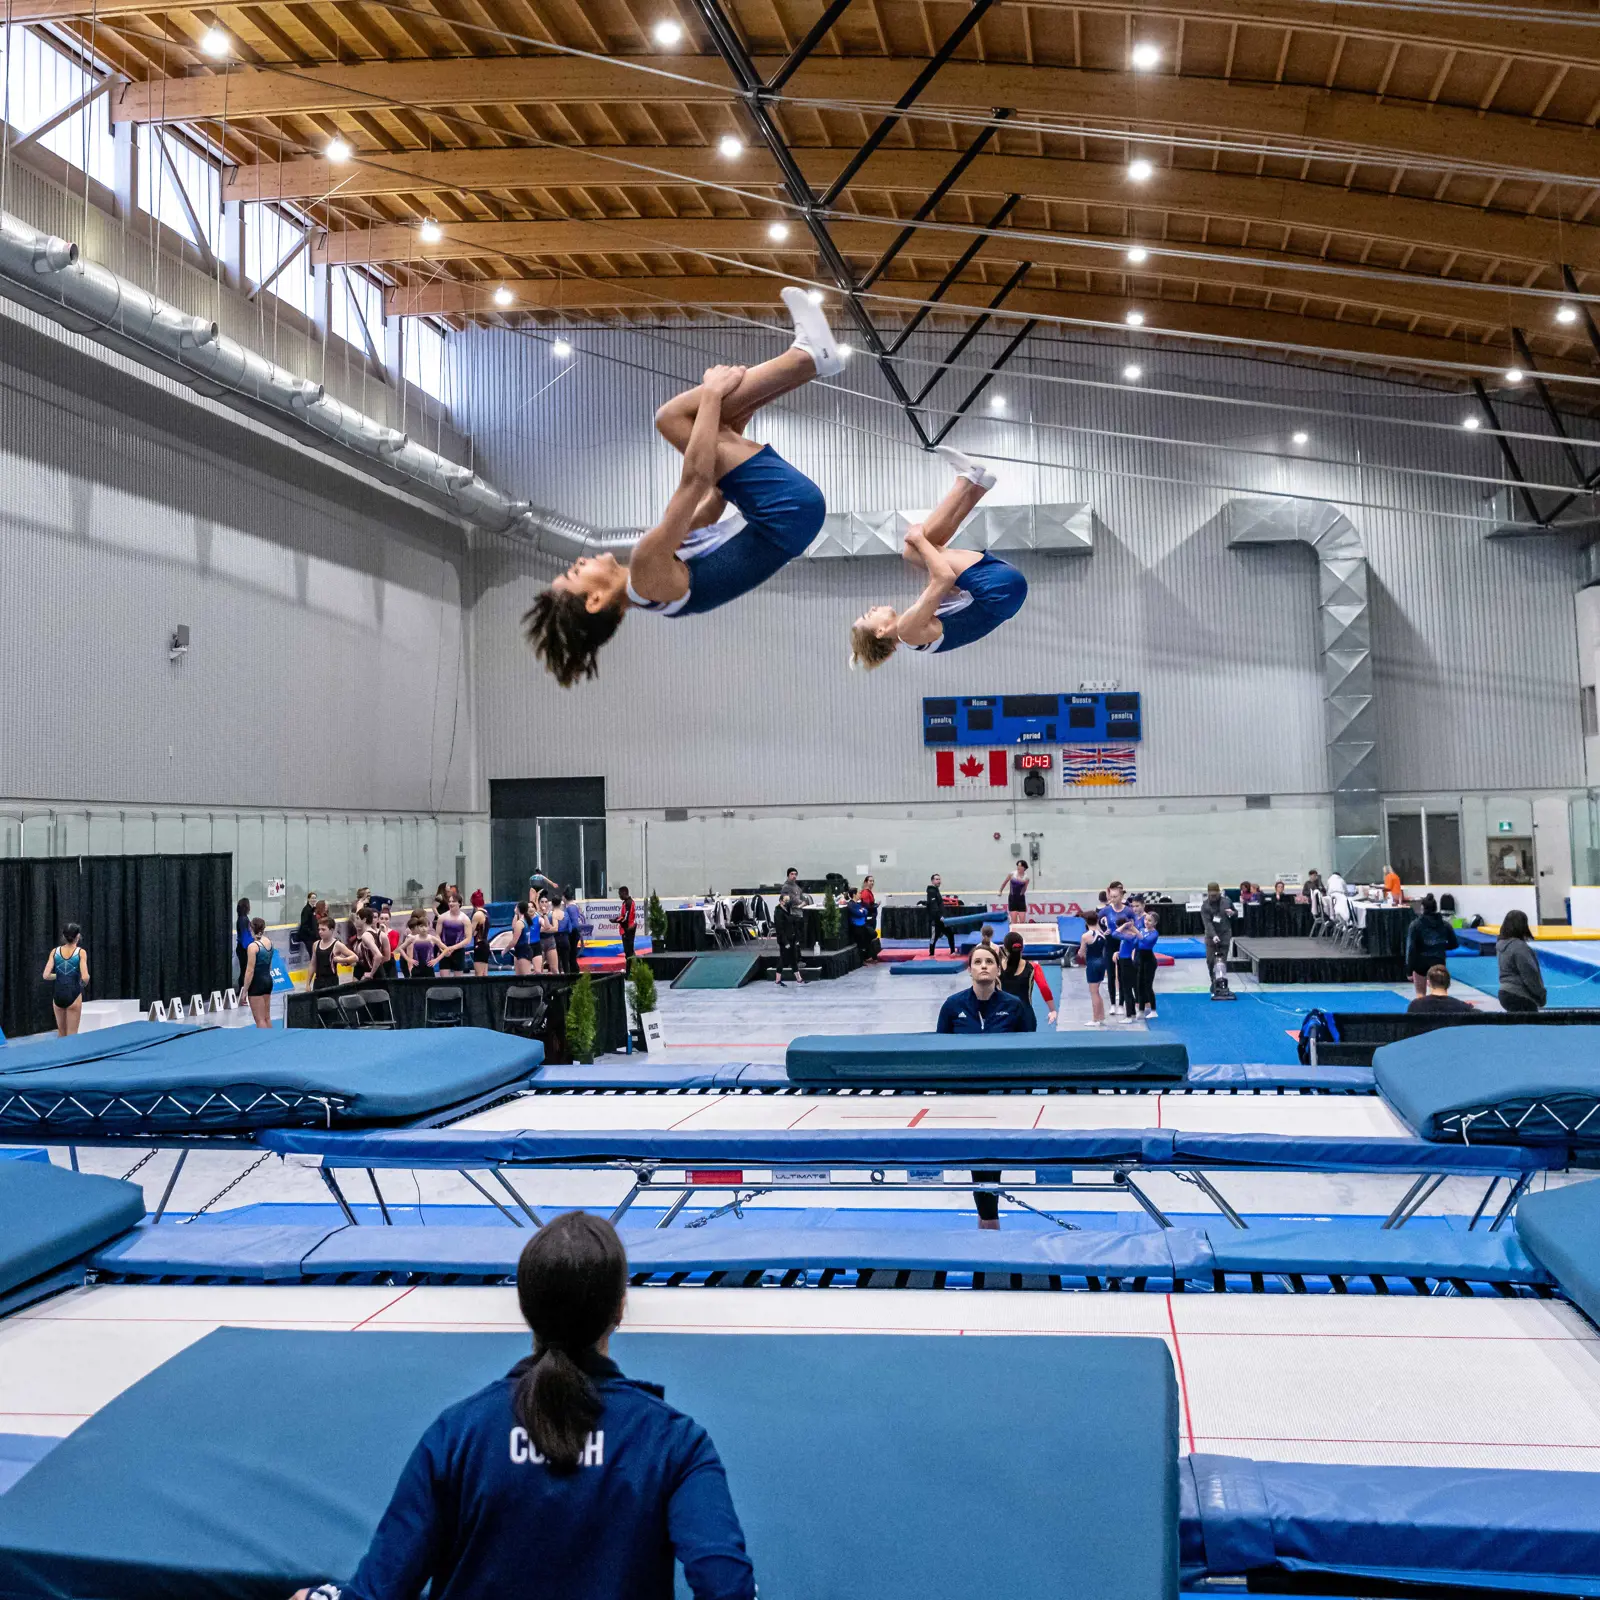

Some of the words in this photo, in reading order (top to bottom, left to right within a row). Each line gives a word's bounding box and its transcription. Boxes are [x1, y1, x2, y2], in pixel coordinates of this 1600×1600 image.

[930, 716, 952, 725] penalty
[1111, 712, 1133, 721] penalty
[1022, 732, 1041, 741] period
[1022, 755, 1049, 768] 10:43
[990, 903, 1083, 915] HNDA
[177, 1003, 182, 1013] 5
[198, 1000, 203, 1010] 6
[509, 1426, 604, 1467] COH
